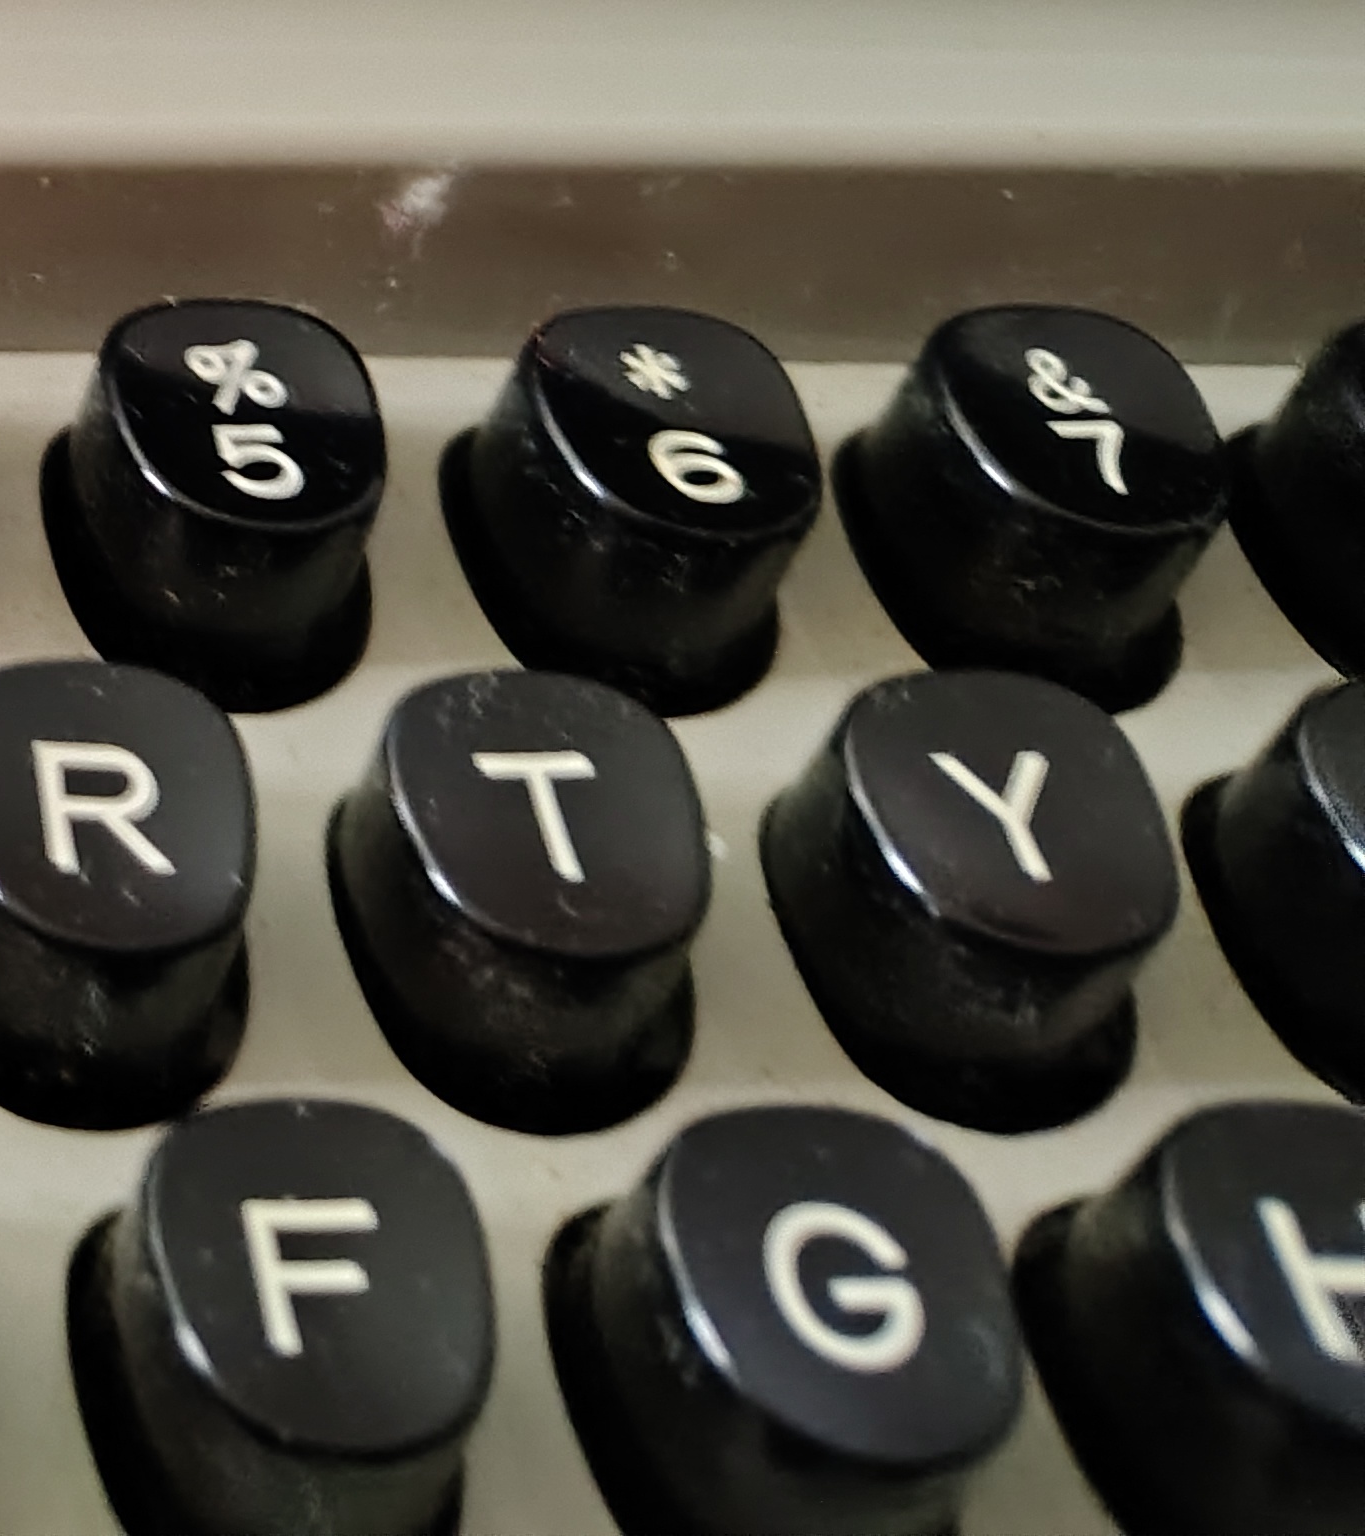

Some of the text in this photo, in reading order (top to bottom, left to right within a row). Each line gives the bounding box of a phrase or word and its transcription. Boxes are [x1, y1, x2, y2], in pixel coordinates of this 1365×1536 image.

[183, 338, 289, 416] %
[1024, 347, 1112, 415] &
[210, 422, 306, 501] 5
[647, 428, 745, 505] 6
[1045, 418, 1130, 496] 7
[30, 738, 178, 877] R
[471, 749, 597, 884] T
[927, 749, 1053, 883] Y
[239, 1196, 379, 1357] F
[762, 1200, 926, 1372] G
